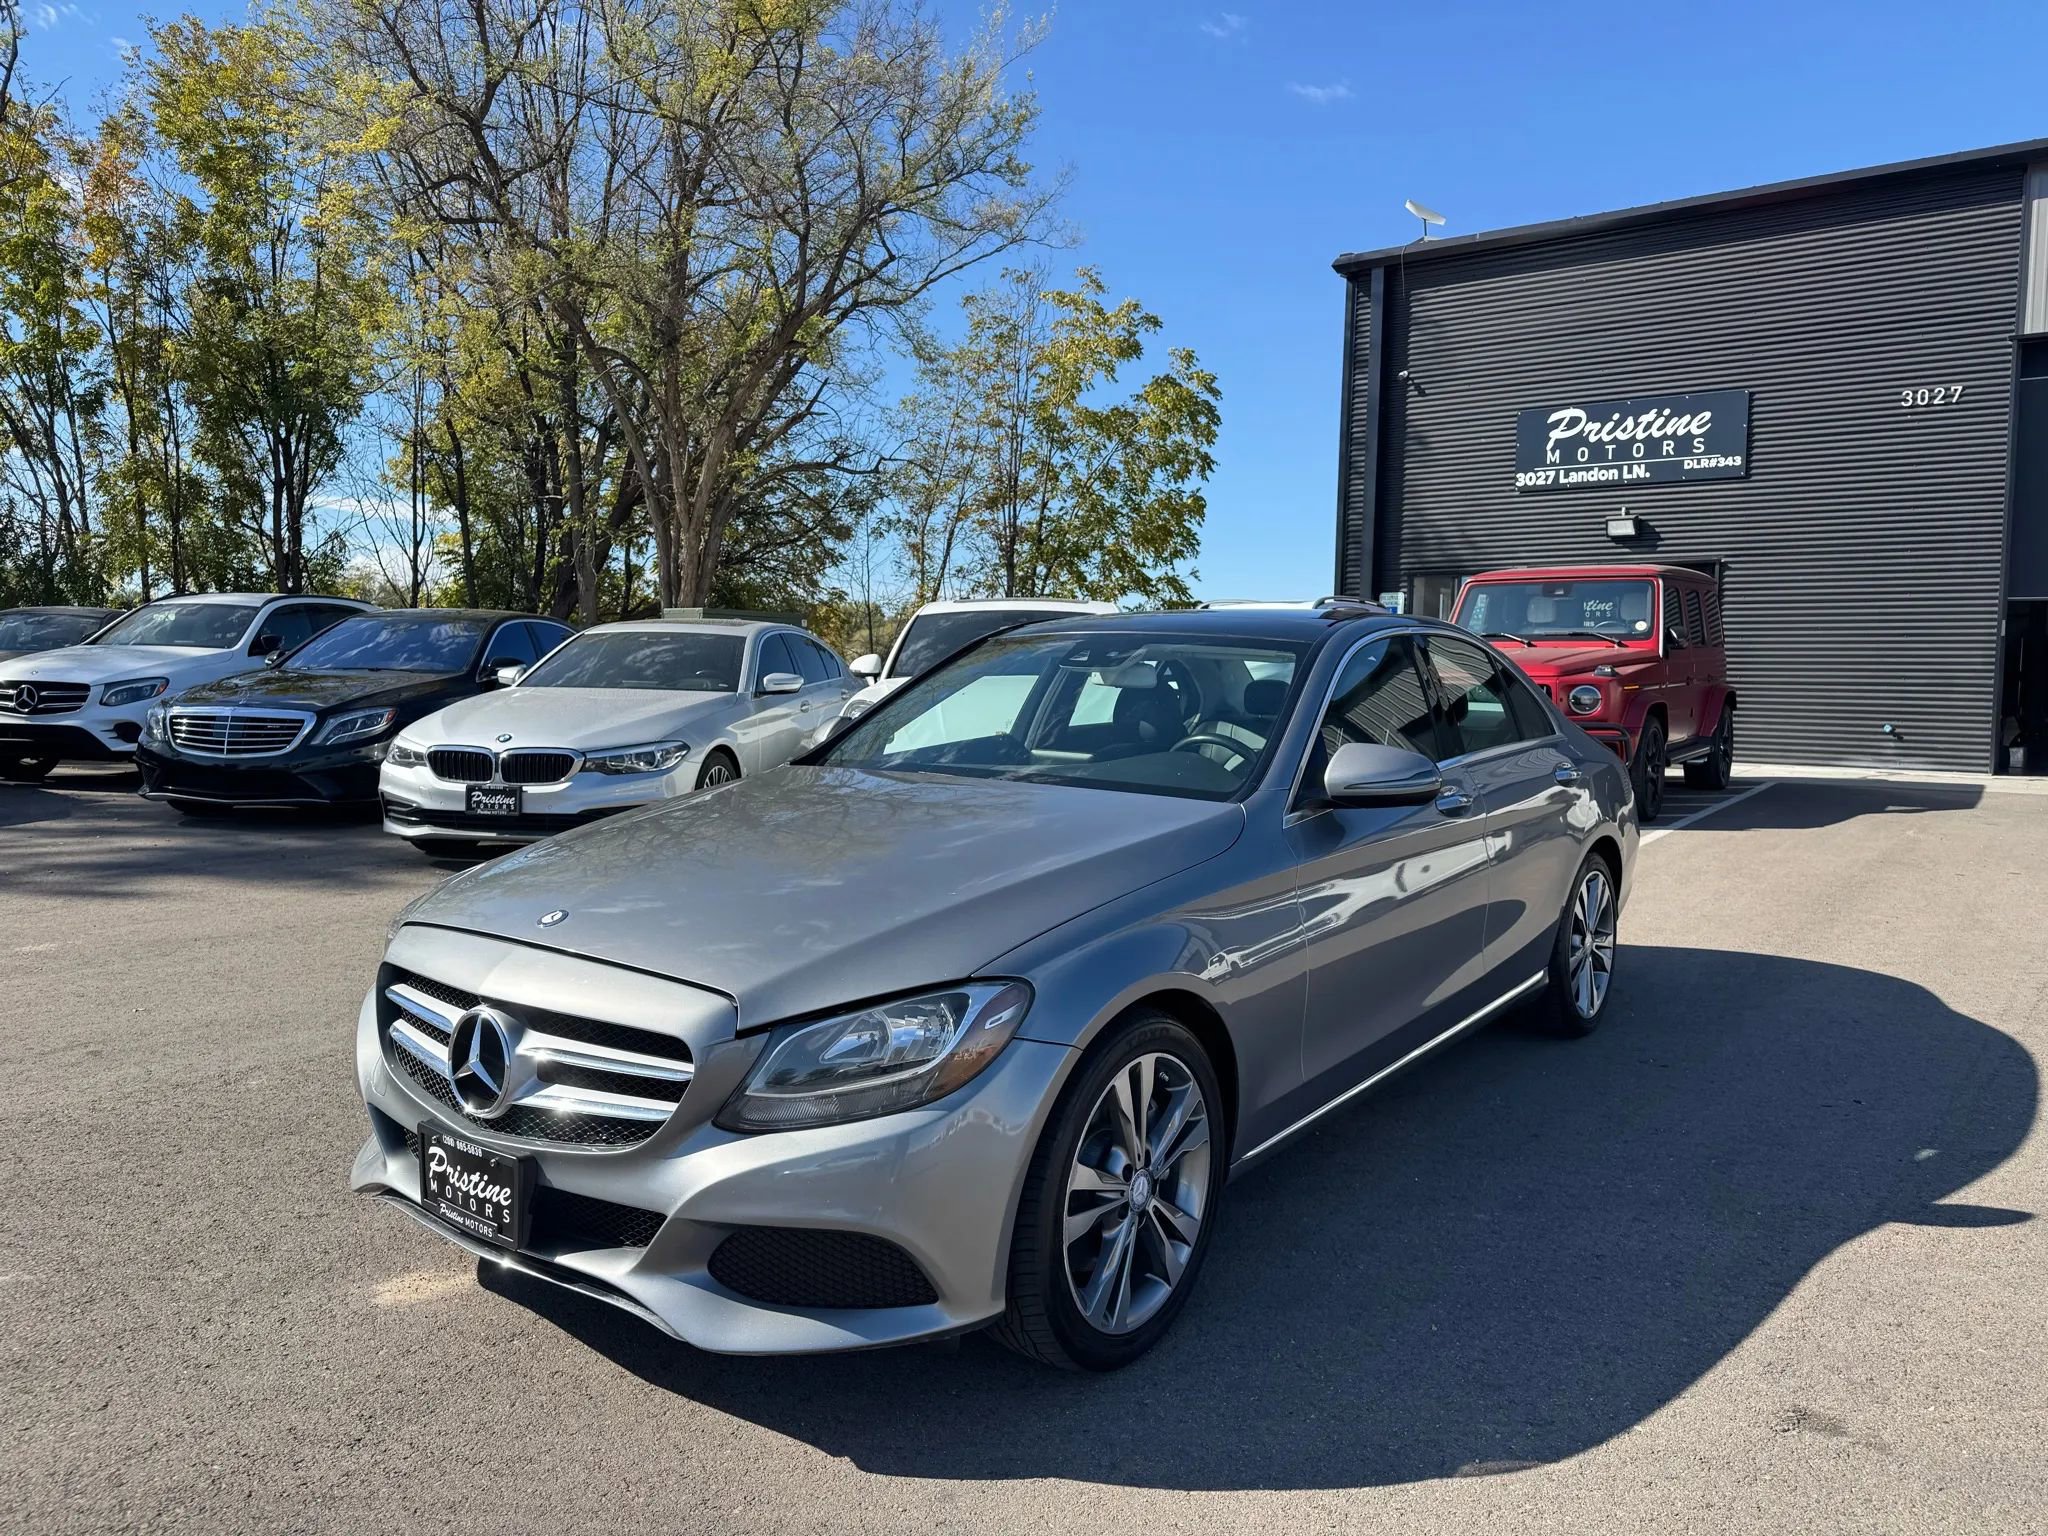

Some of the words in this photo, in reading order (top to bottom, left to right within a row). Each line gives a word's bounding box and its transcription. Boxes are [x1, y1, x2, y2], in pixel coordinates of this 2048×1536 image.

[1901, 385, 1963, 407] 3027
[1546, 408, 1712, 451] Pristine
[1546, 437, 1705, 465] MOTORS
[1683, 456, 1742, 470] DLR#343
[1515, 470, 1556, 487] 3027
[1559, 467, 1619, 484] Landon
[1622, 464, 1651, 480] LN.
[471, 791, 516, 805] Pristine
[428, 1146, 512, 1206] Pristine
[430, 1178, 511, 1223] MOTORS
[465, 1219, 493, 1238] MOTORS
